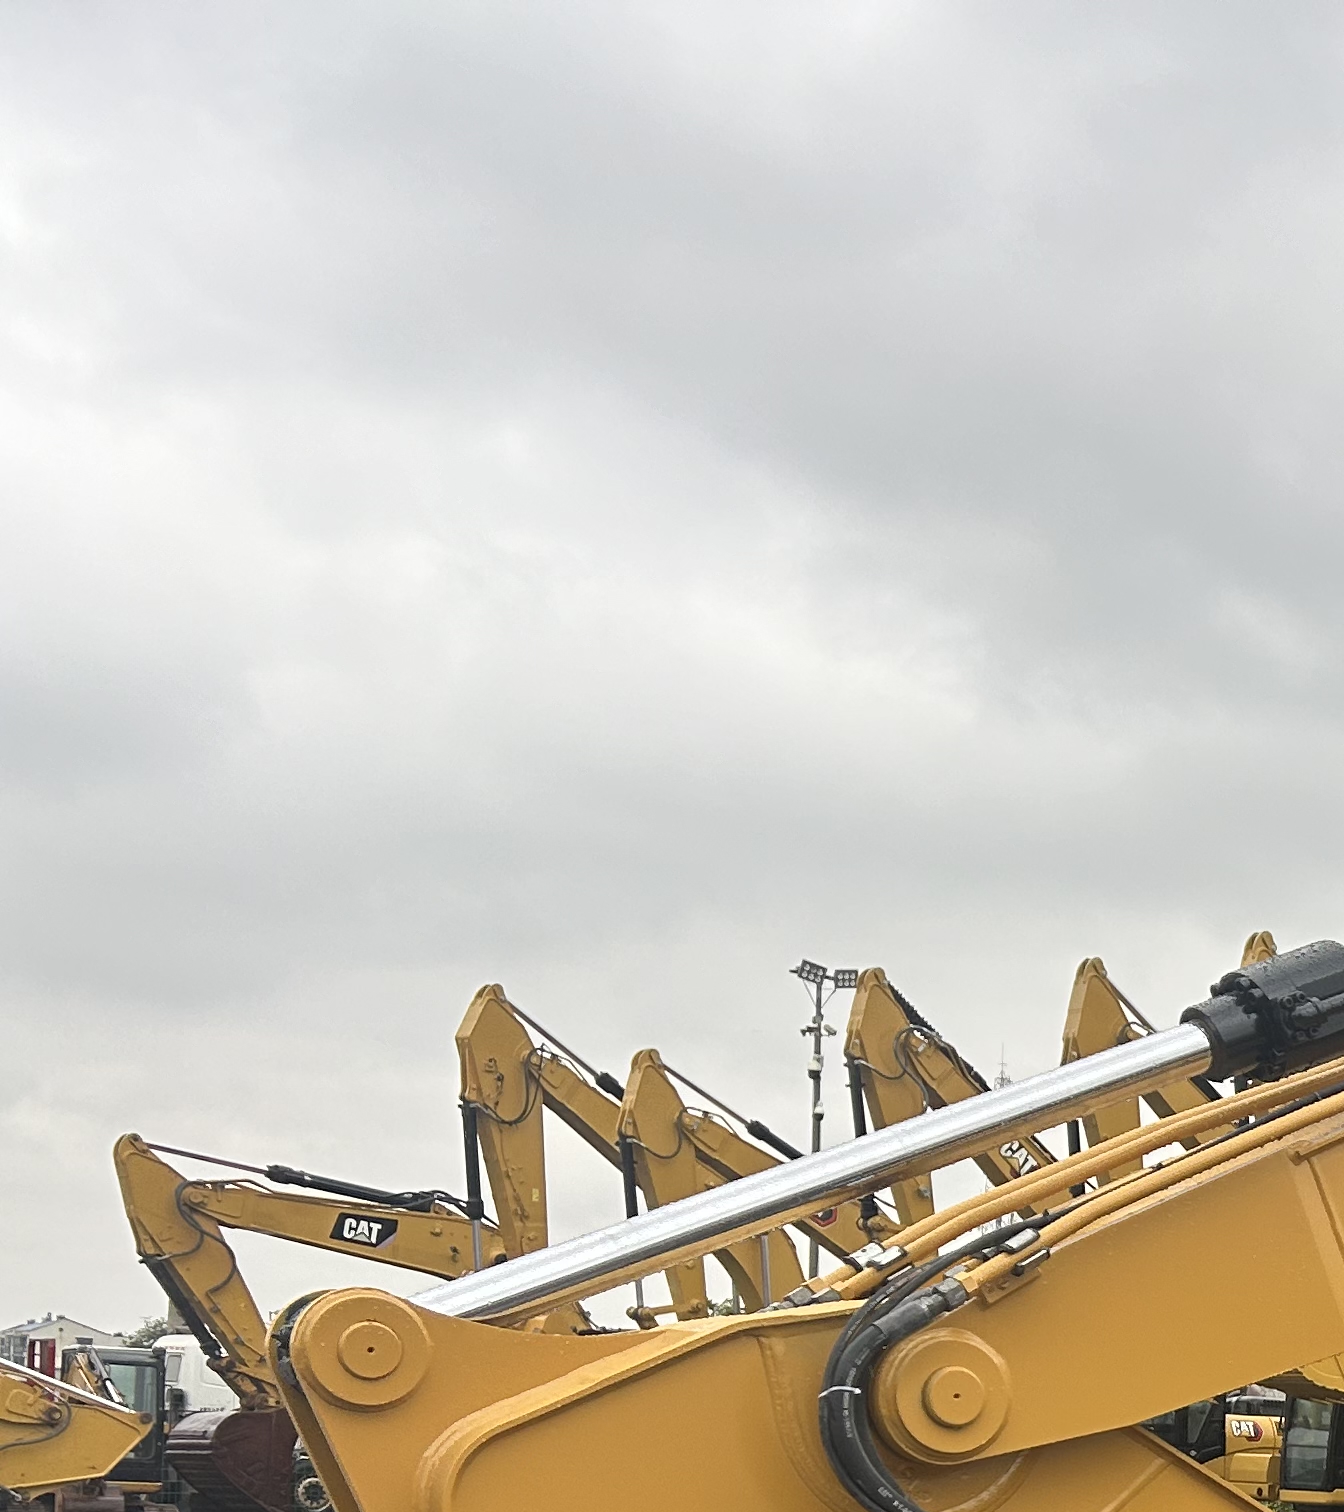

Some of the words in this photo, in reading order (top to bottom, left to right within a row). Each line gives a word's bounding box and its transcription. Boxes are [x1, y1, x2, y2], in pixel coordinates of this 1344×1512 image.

[1000, 1140, 1038, 1176] CAT
[343, 1217, 382, 1244] CAT
[1231, 1420, 1255, 1437] CAT
